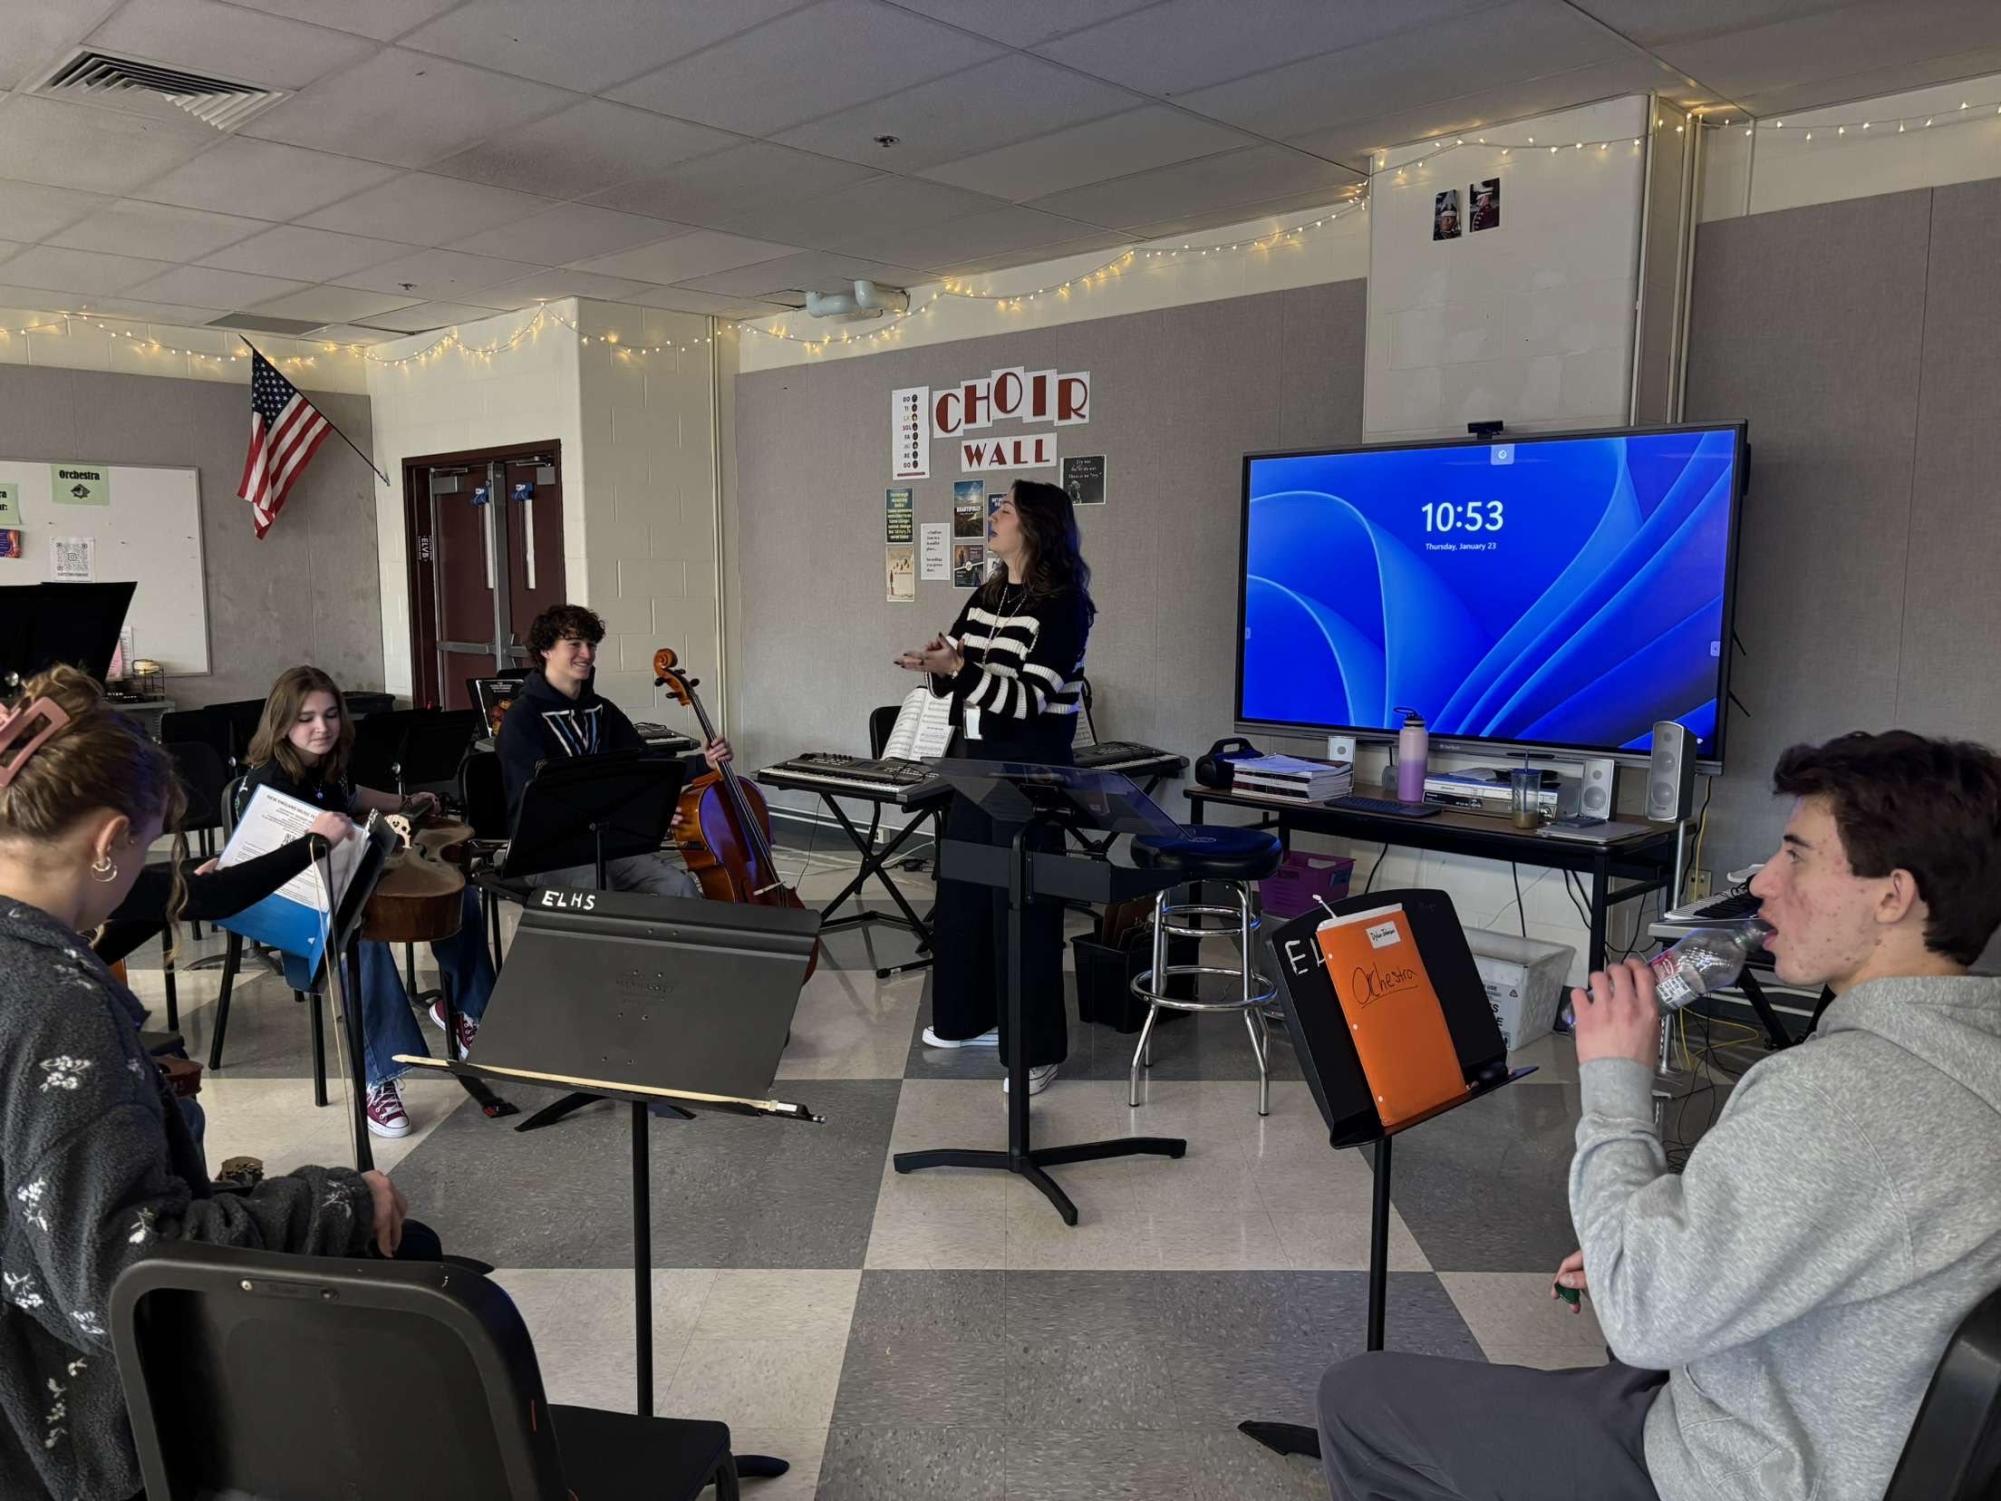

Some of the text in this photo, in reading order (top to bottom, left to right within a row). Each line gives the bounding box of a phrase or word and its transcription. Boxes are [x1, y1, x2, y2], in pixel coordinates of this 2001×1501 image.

[935, 372, 1088, 433] CHOIR
[963, 439, 1050, 467] WALL
[59, 469, 100, 480] Orchestra
[1421, 500, 1504, 532] 10:53
[1425, 542, 1497, 551] Thursday, January 23
[541, 890, 596, 910] ELHS
